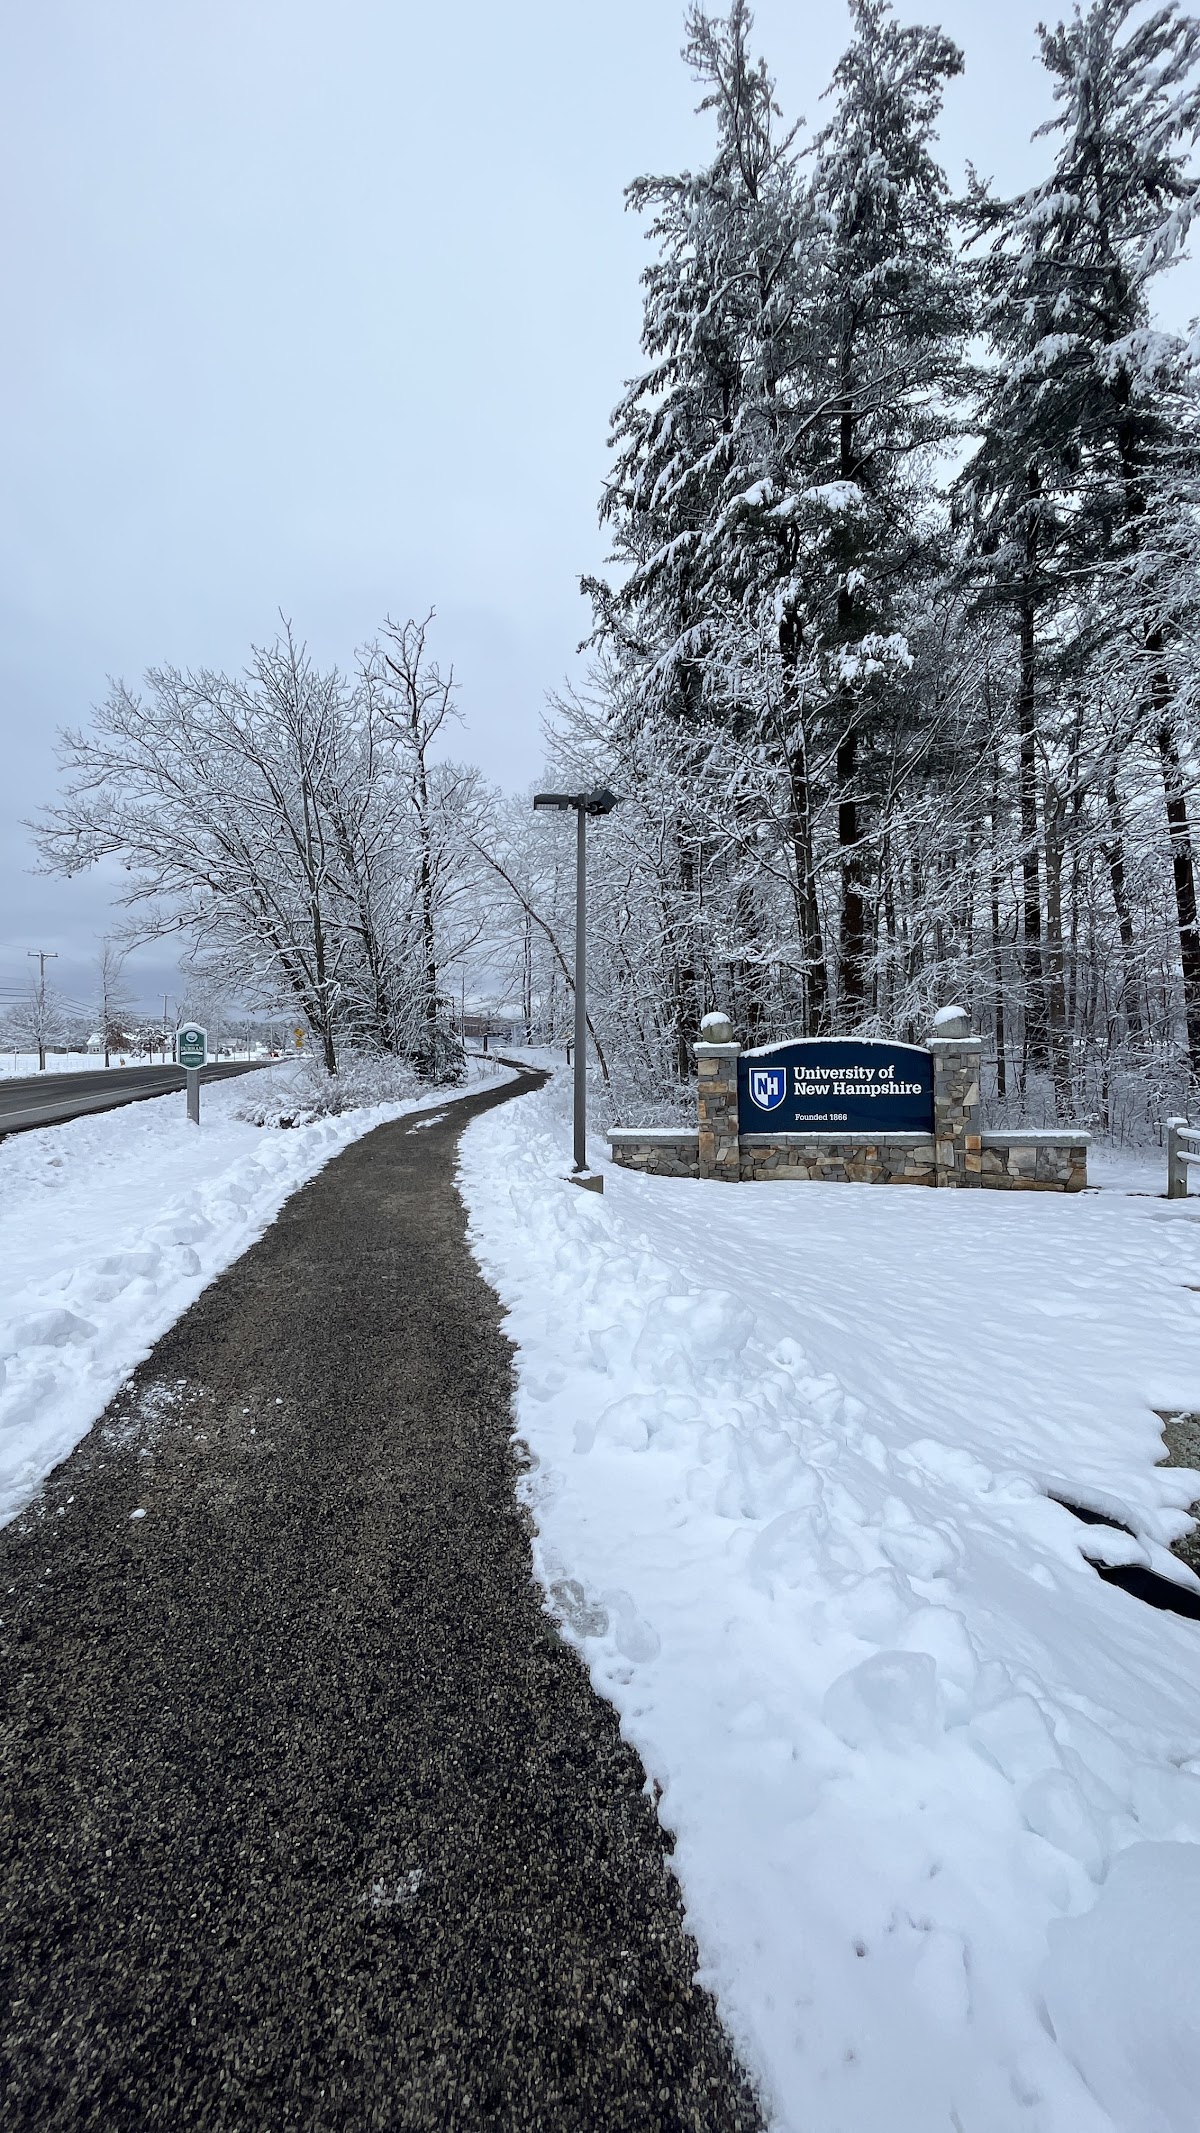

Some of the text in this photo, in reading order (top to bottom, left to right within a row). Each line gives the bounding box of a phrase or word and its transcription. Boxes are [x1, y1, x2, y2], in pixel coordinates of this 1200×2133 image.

[794, 1065, 895, 1082] University of
[757, 1077, 779, 1095] NH
[794, 1081, 922, 1097] New Hampshire
[795, 1113, 848, 1121] Founded 1866
